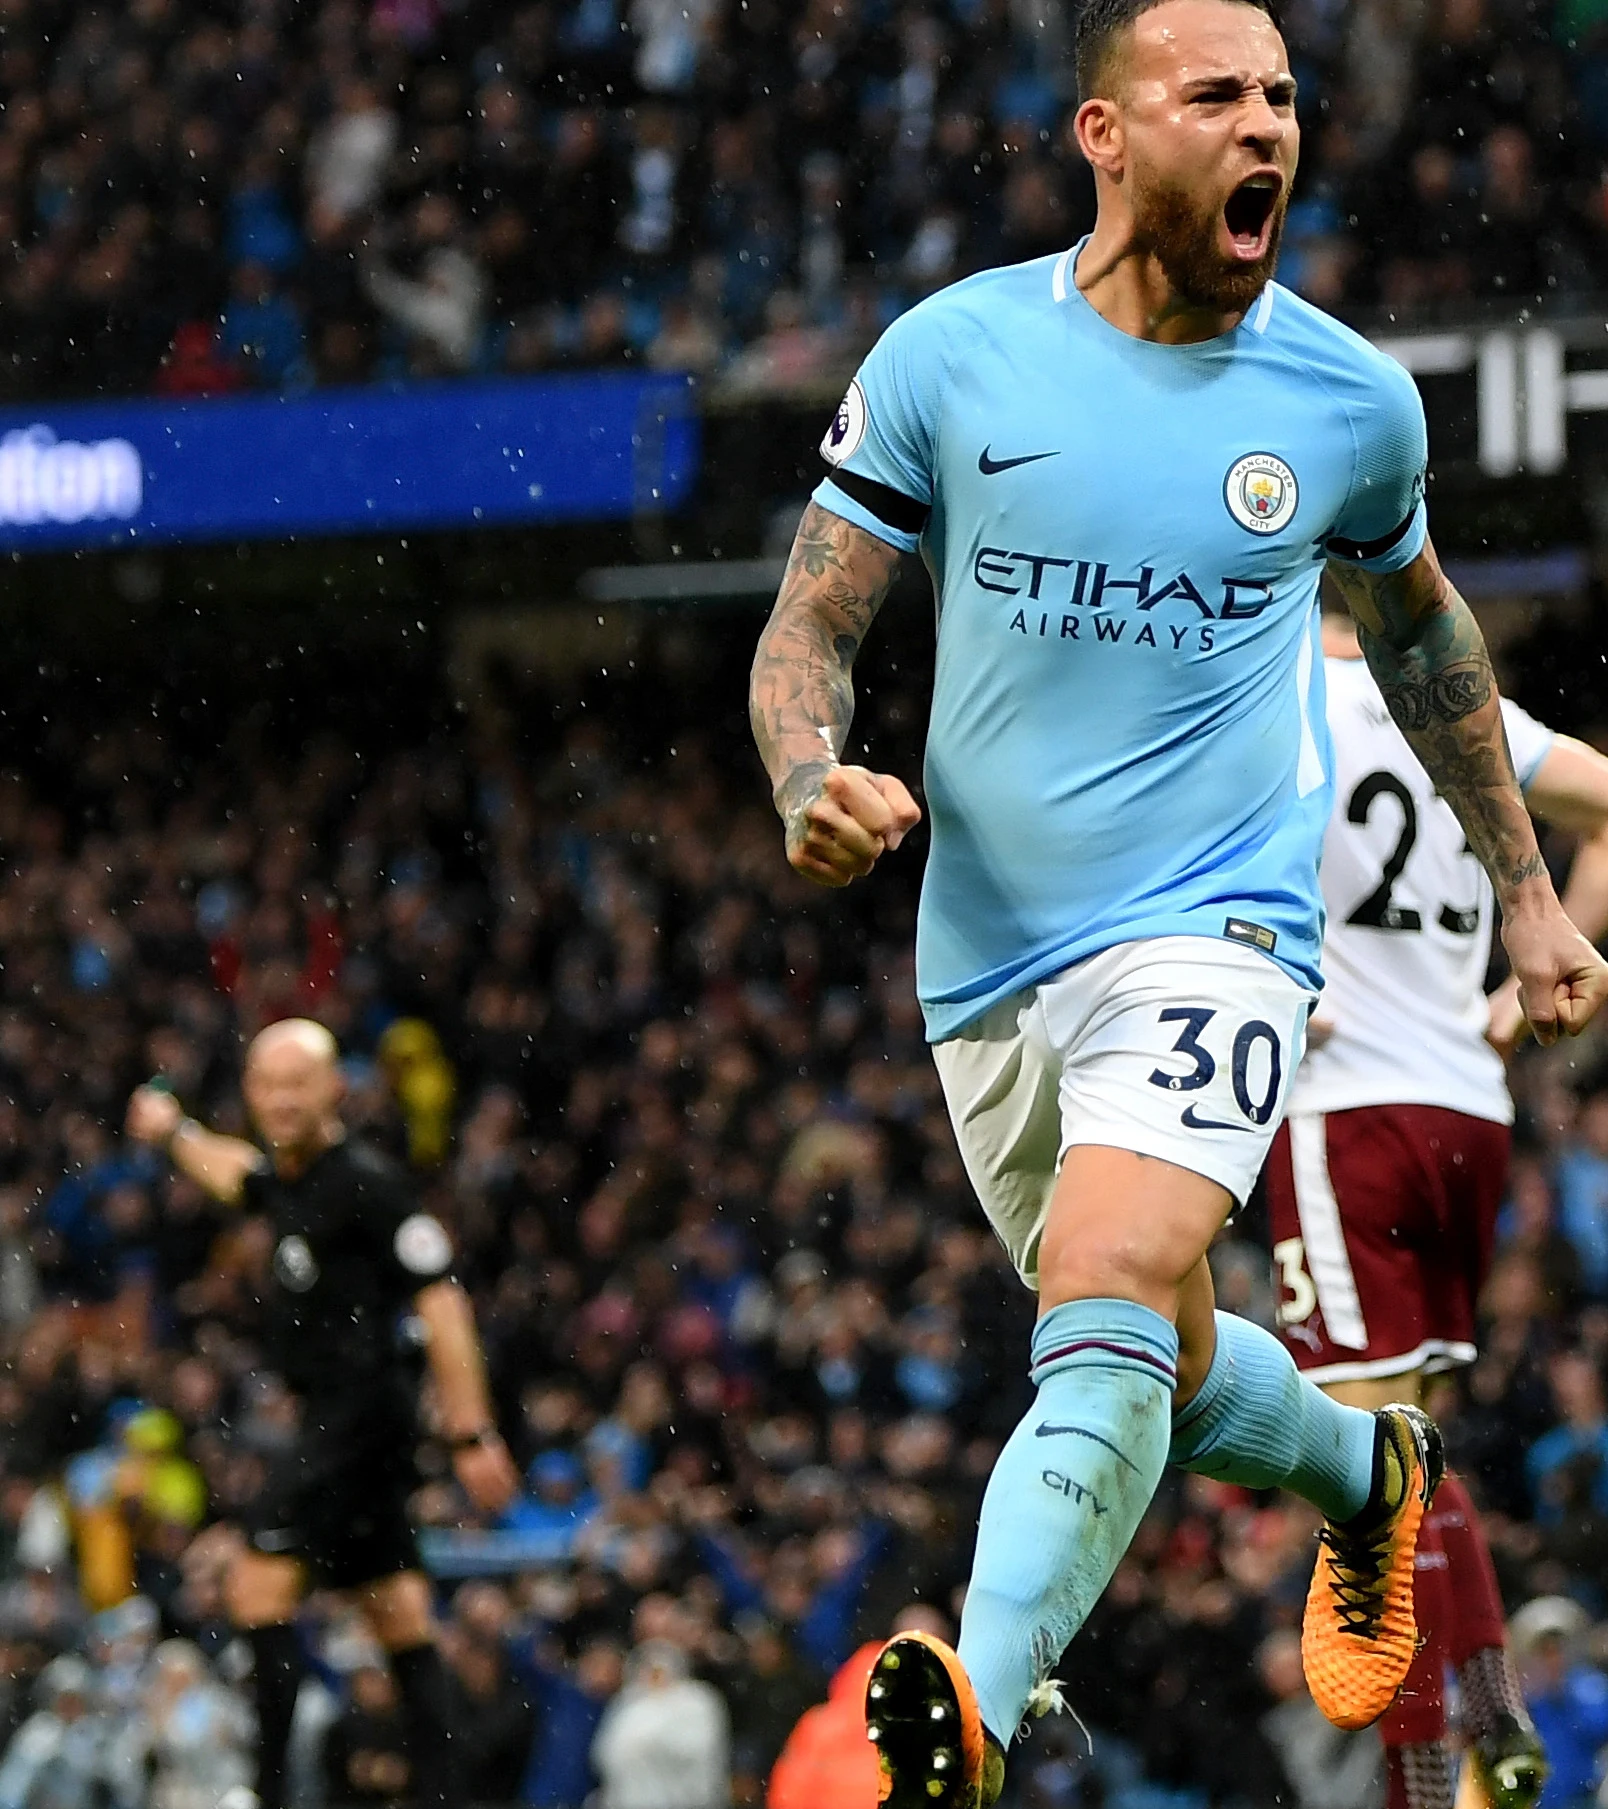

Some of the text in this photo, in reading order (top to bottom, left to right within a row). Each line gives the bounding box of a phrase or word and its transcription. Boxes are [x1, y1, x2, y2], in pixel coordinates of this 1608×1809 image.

[1234, 458, 1293, 489] MANCHESTER
[1249, 519, 1270, 530] CITY
[974, 546, 1273, 619] ETIHAD
[1009, 608, 1216, 652] AIRWAYS
[1147, 1007, 1281, 1125] 30
[1042, 1469, 1108, 1517] CITY
